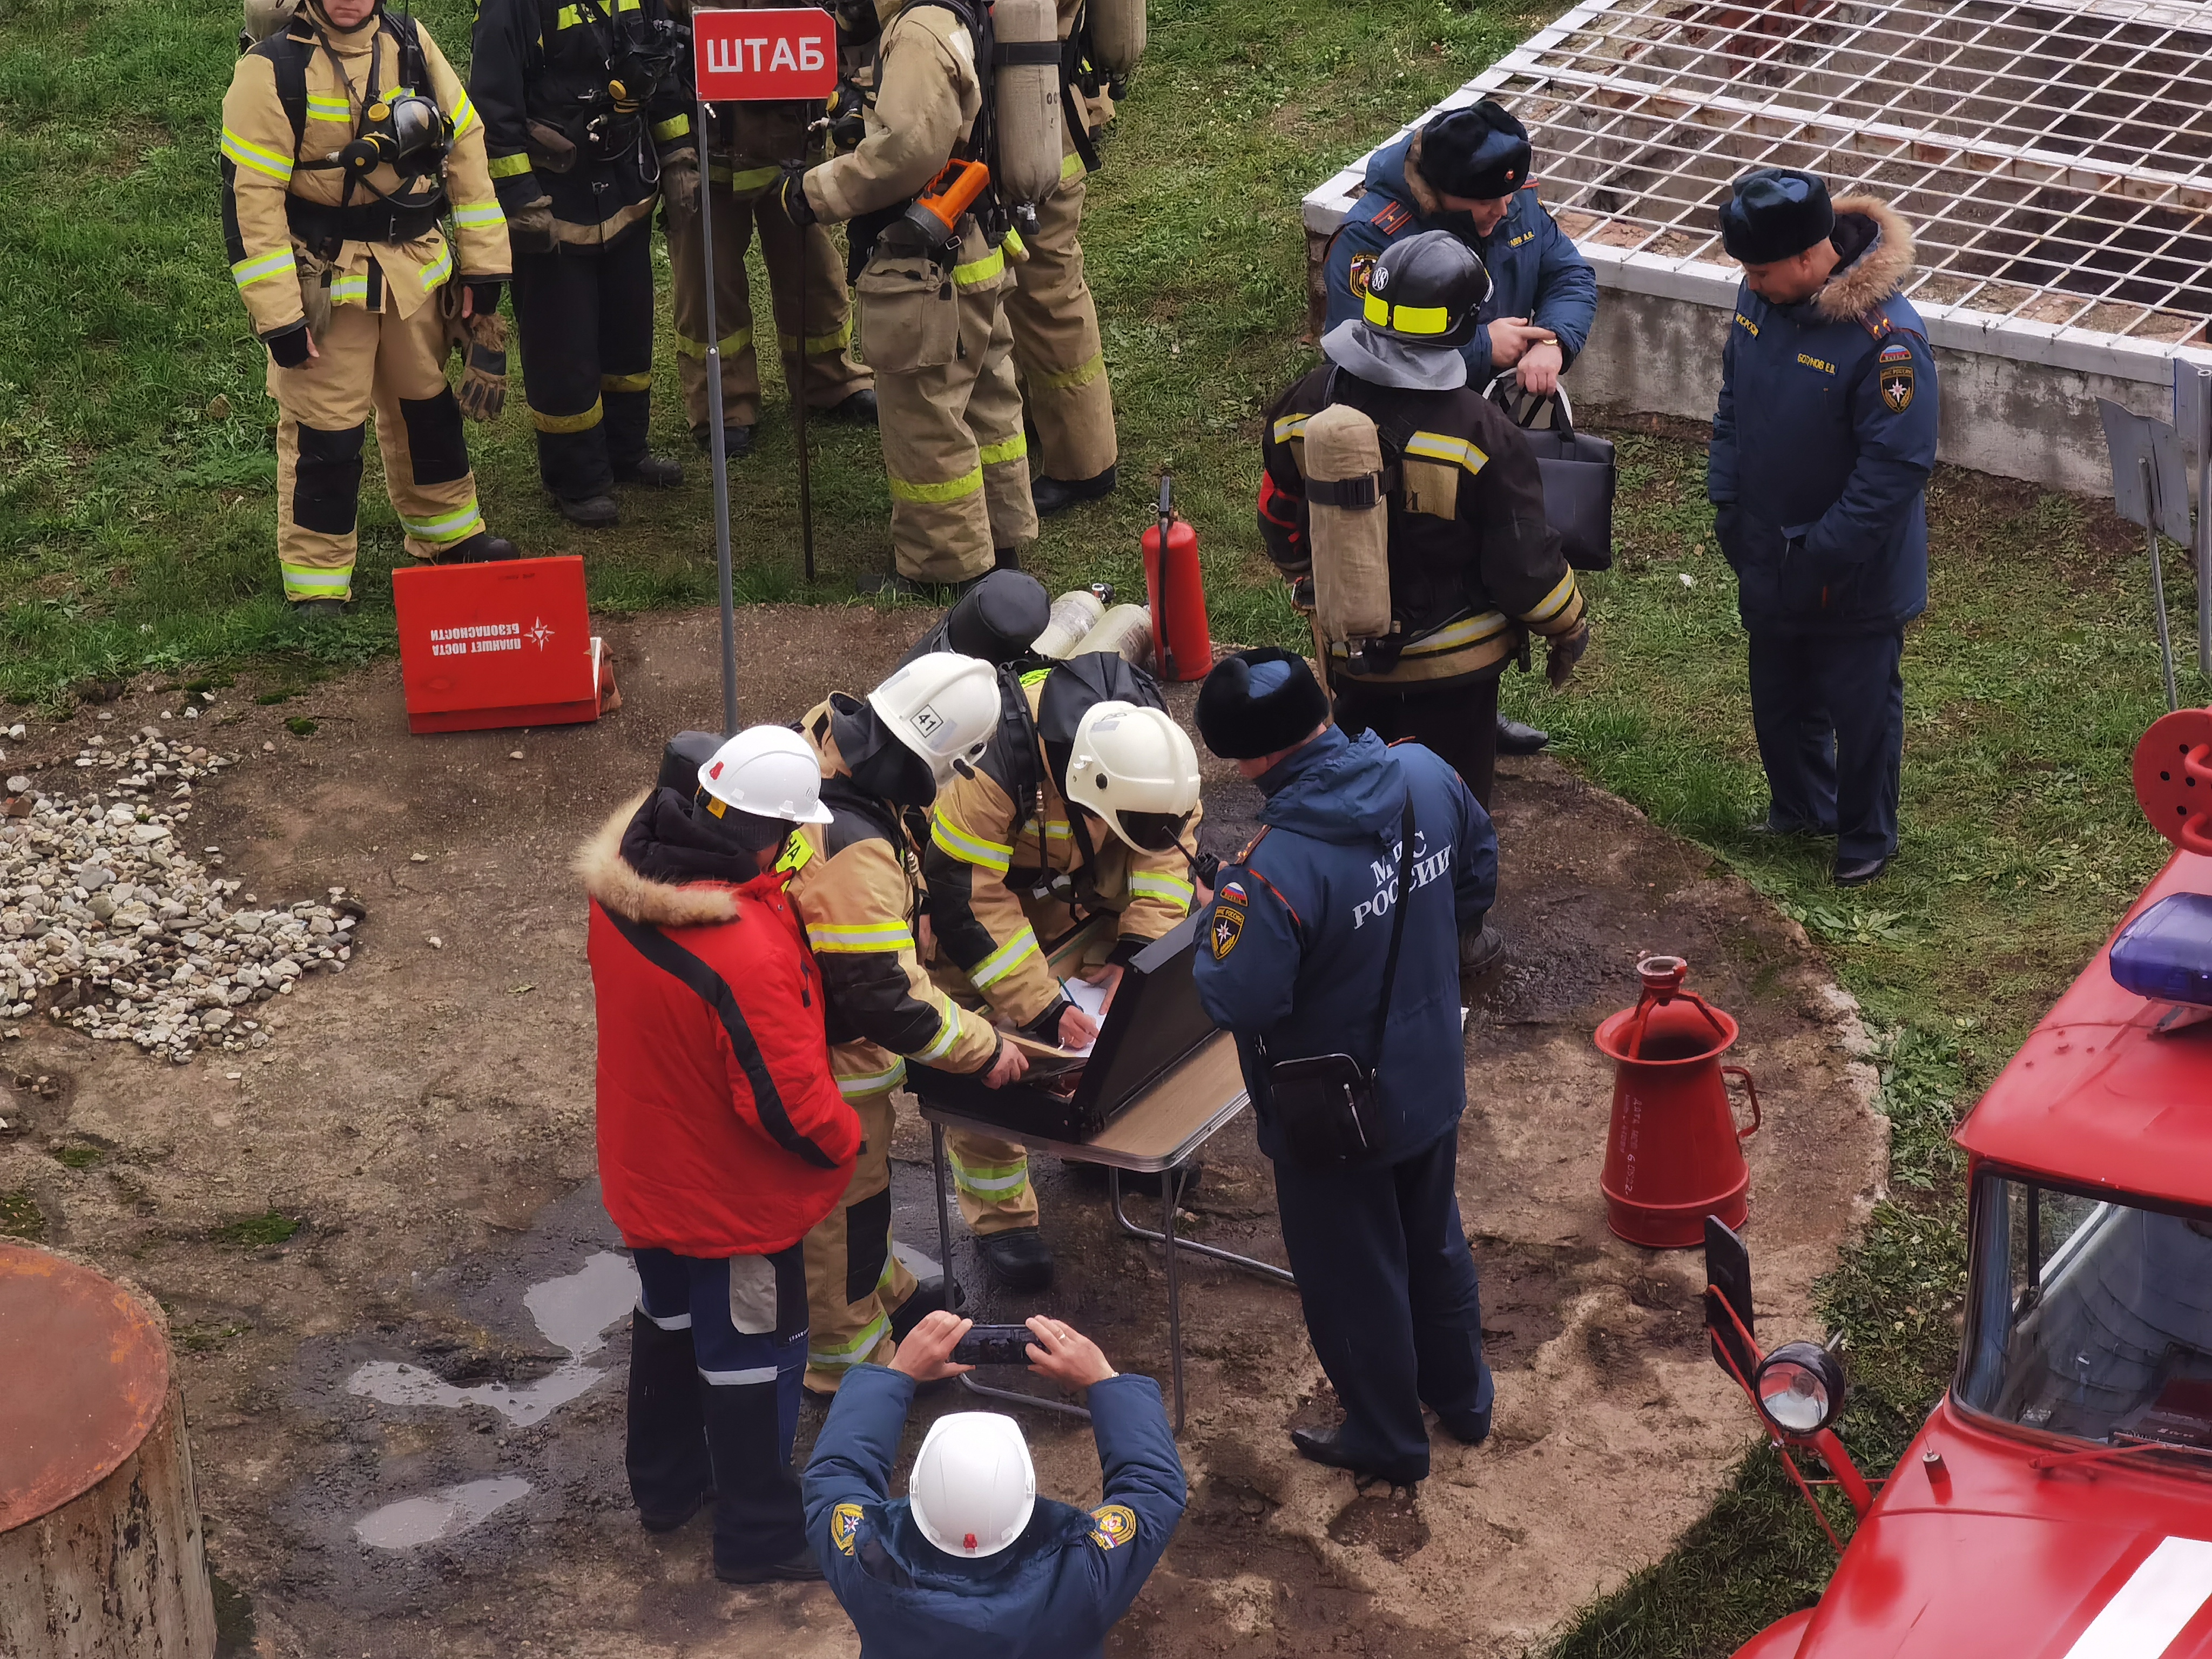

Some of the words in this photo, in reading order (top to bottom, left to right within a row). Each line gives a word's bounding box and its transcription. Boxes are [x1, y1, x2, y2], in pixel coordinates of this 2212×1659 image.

[707, 37, 825, 73] ШТАБ
[430, 623, 520, 641] БЕЗОПАСНОСТИ
[432, 642, 467, 656] ПОСТА
[470, 638, 521, 653] ПЛАНШЕТ
[918, 713, 936, 731] 41
